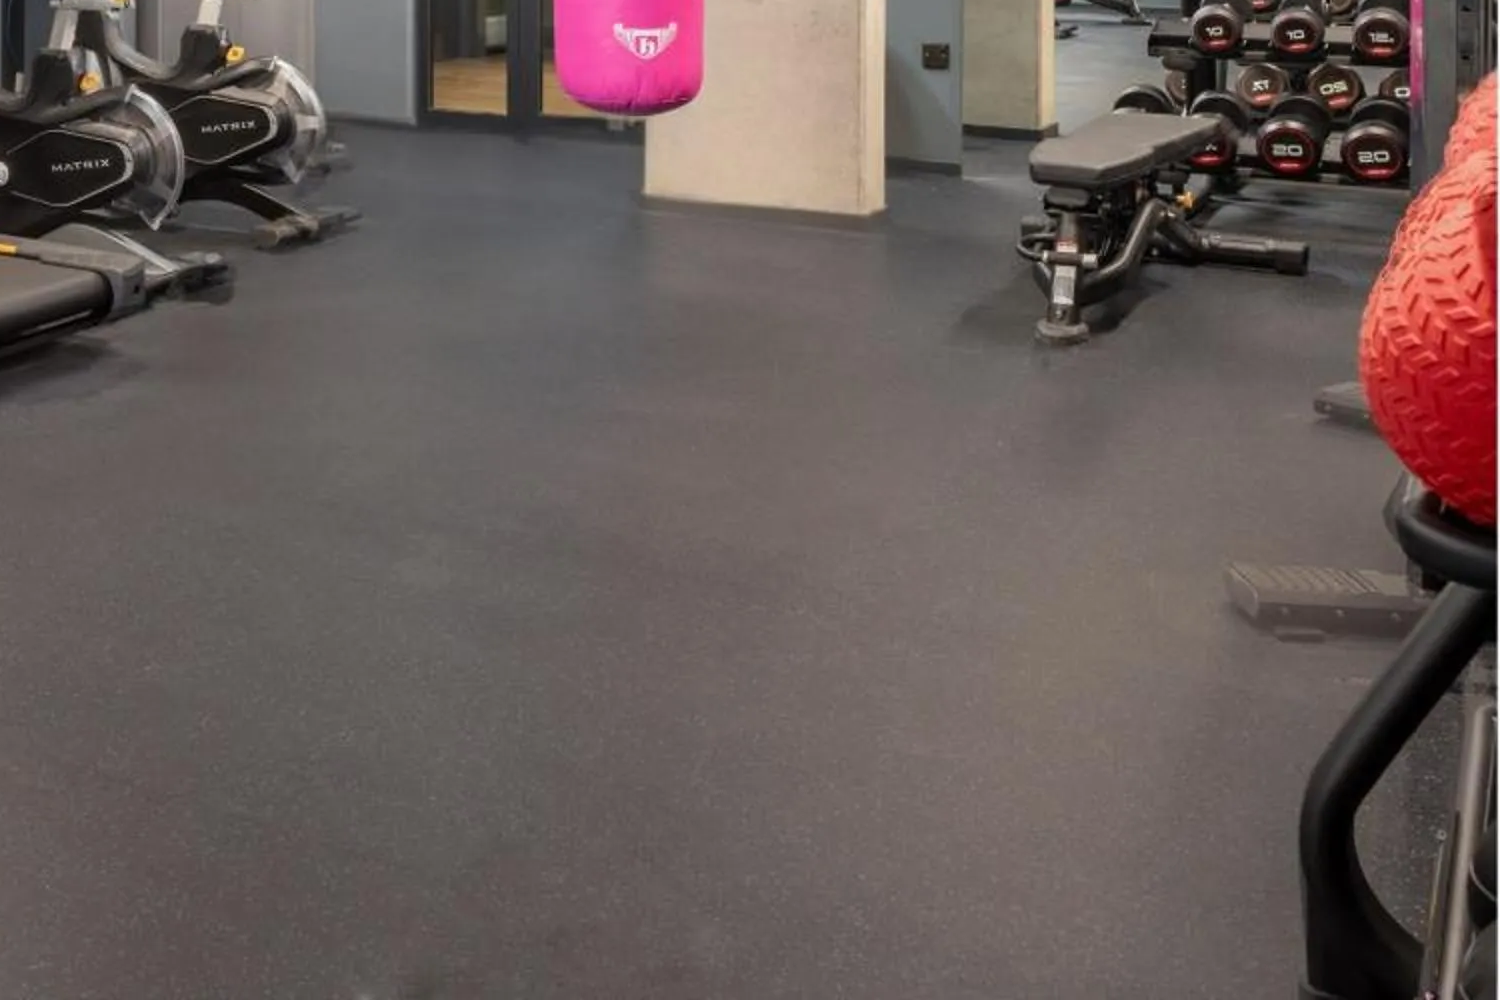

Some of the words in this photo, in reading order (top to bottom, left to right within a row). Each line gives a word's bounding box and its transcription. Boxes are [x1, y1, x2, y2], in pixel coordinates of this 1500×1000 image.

[1205, 26, 1223, 37] 10
[1286, 29, 1305, 40] 10
[200, 119, 257, 134] MATRIX
[1272, 143, 1303, 157] 20
[1357, 150, 1390, 164] 20
[50, 157, 111, 173] MATRIX
